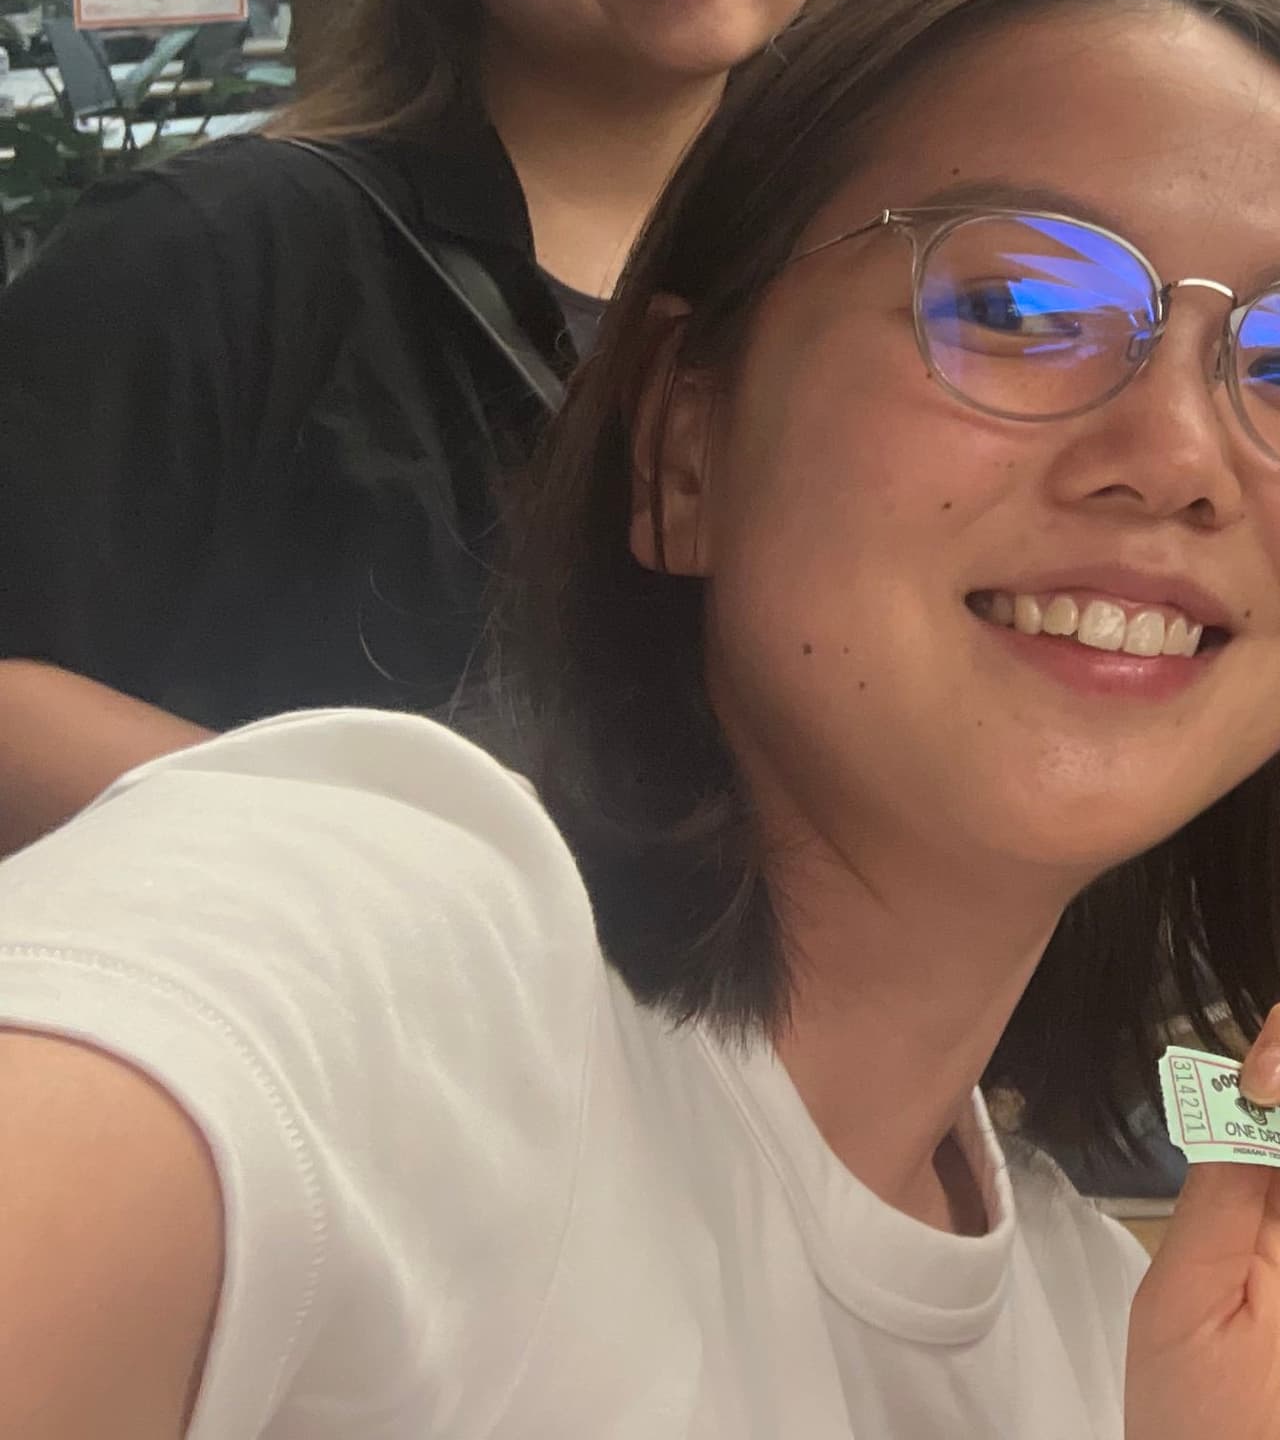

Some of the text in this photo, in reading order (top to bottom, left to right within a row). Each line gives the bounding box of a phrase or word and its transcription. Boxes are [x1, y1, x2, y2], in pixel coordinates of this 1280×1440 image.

[1211, 1073, 1241, 1092] GOO
[1172, 1060, 1207, 1132] 314271
[1225, 1121, 1255, 1139] ONE
